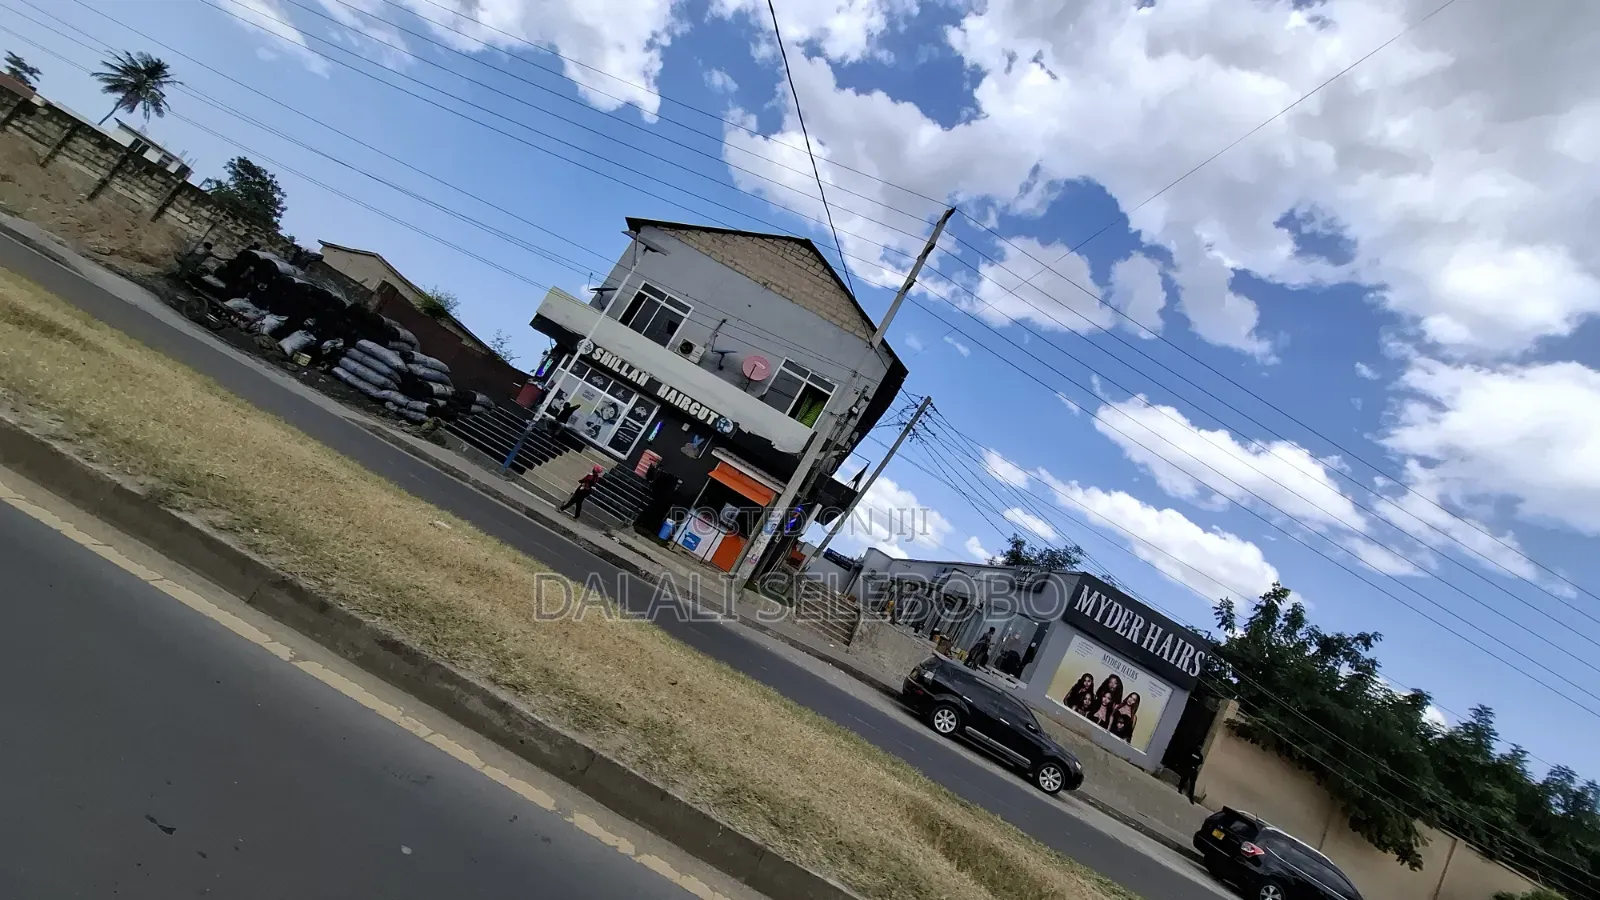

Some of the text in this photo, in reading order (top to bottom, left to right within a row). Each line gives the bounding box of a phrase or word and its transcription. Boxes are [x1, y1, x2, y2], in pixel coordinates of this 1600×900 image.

[591, 347, 719, 426] SHILLAH HAIRCUT
[1073, 584, 1206, 677] MYDER HAIRS
